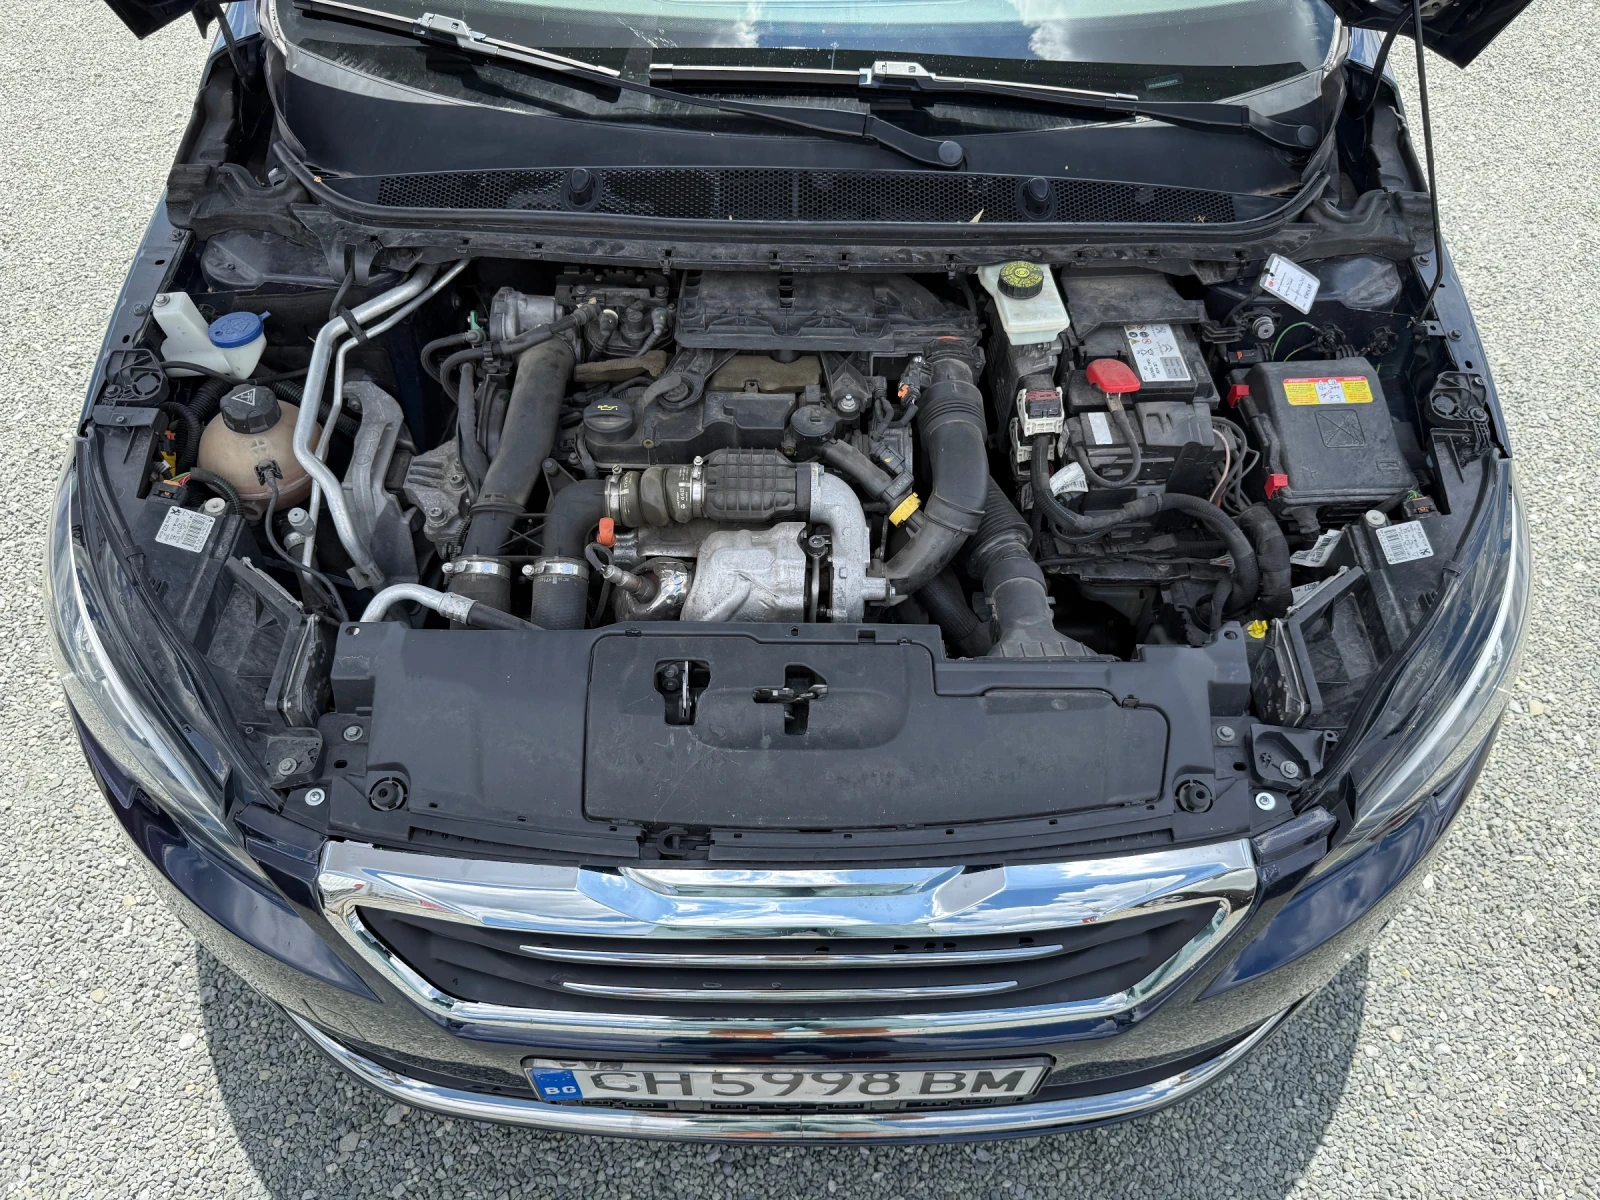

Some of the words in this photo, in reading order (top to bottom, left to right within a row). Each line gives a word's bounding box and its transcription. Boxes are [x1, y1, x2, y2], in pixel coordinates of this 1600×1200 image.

[544, 1085, 577, 1094] BG
[591, 1072, 693, 1096] CH
[711, 1072, 900, 1096] 5998
[918, 1070, 1027, 1094] BM
